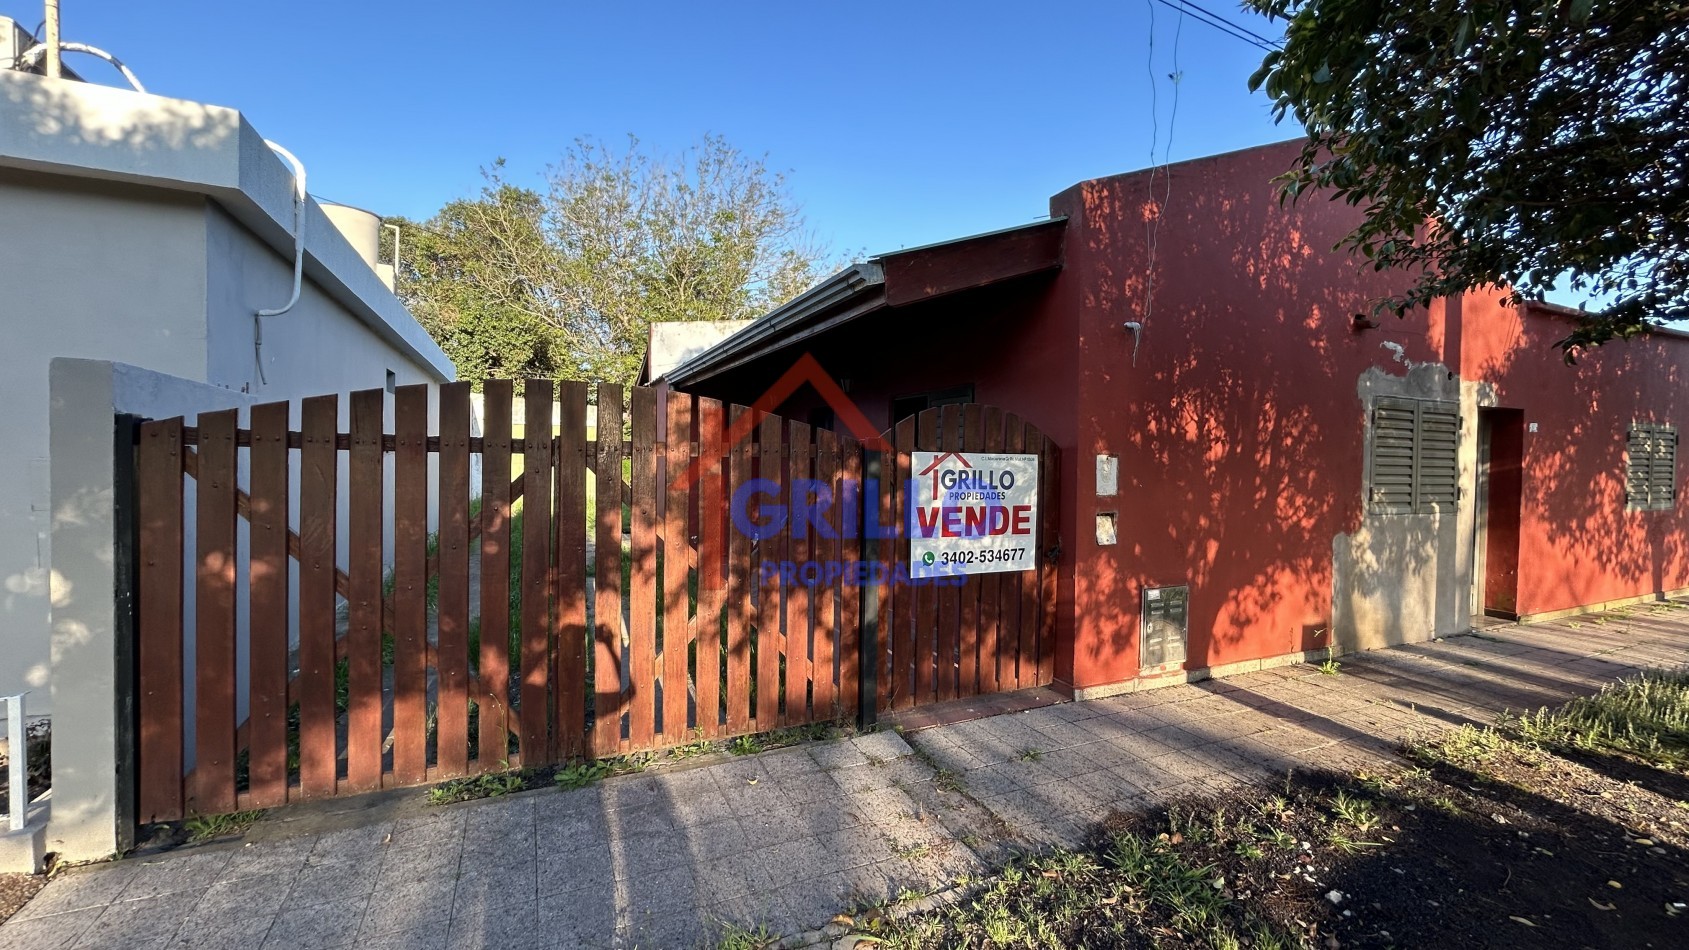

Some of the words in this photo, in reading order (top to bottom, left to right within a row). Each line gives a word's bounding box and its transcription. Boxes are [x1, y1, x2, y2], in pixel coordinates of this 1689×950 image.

[941, 469, 1015, 491] GRILLO
[949, 491, 1006, 501] PROPIEDADES
[916, 505, 1031, 538] VENDE
[941, 547, 1025, 565] 3402-534677
